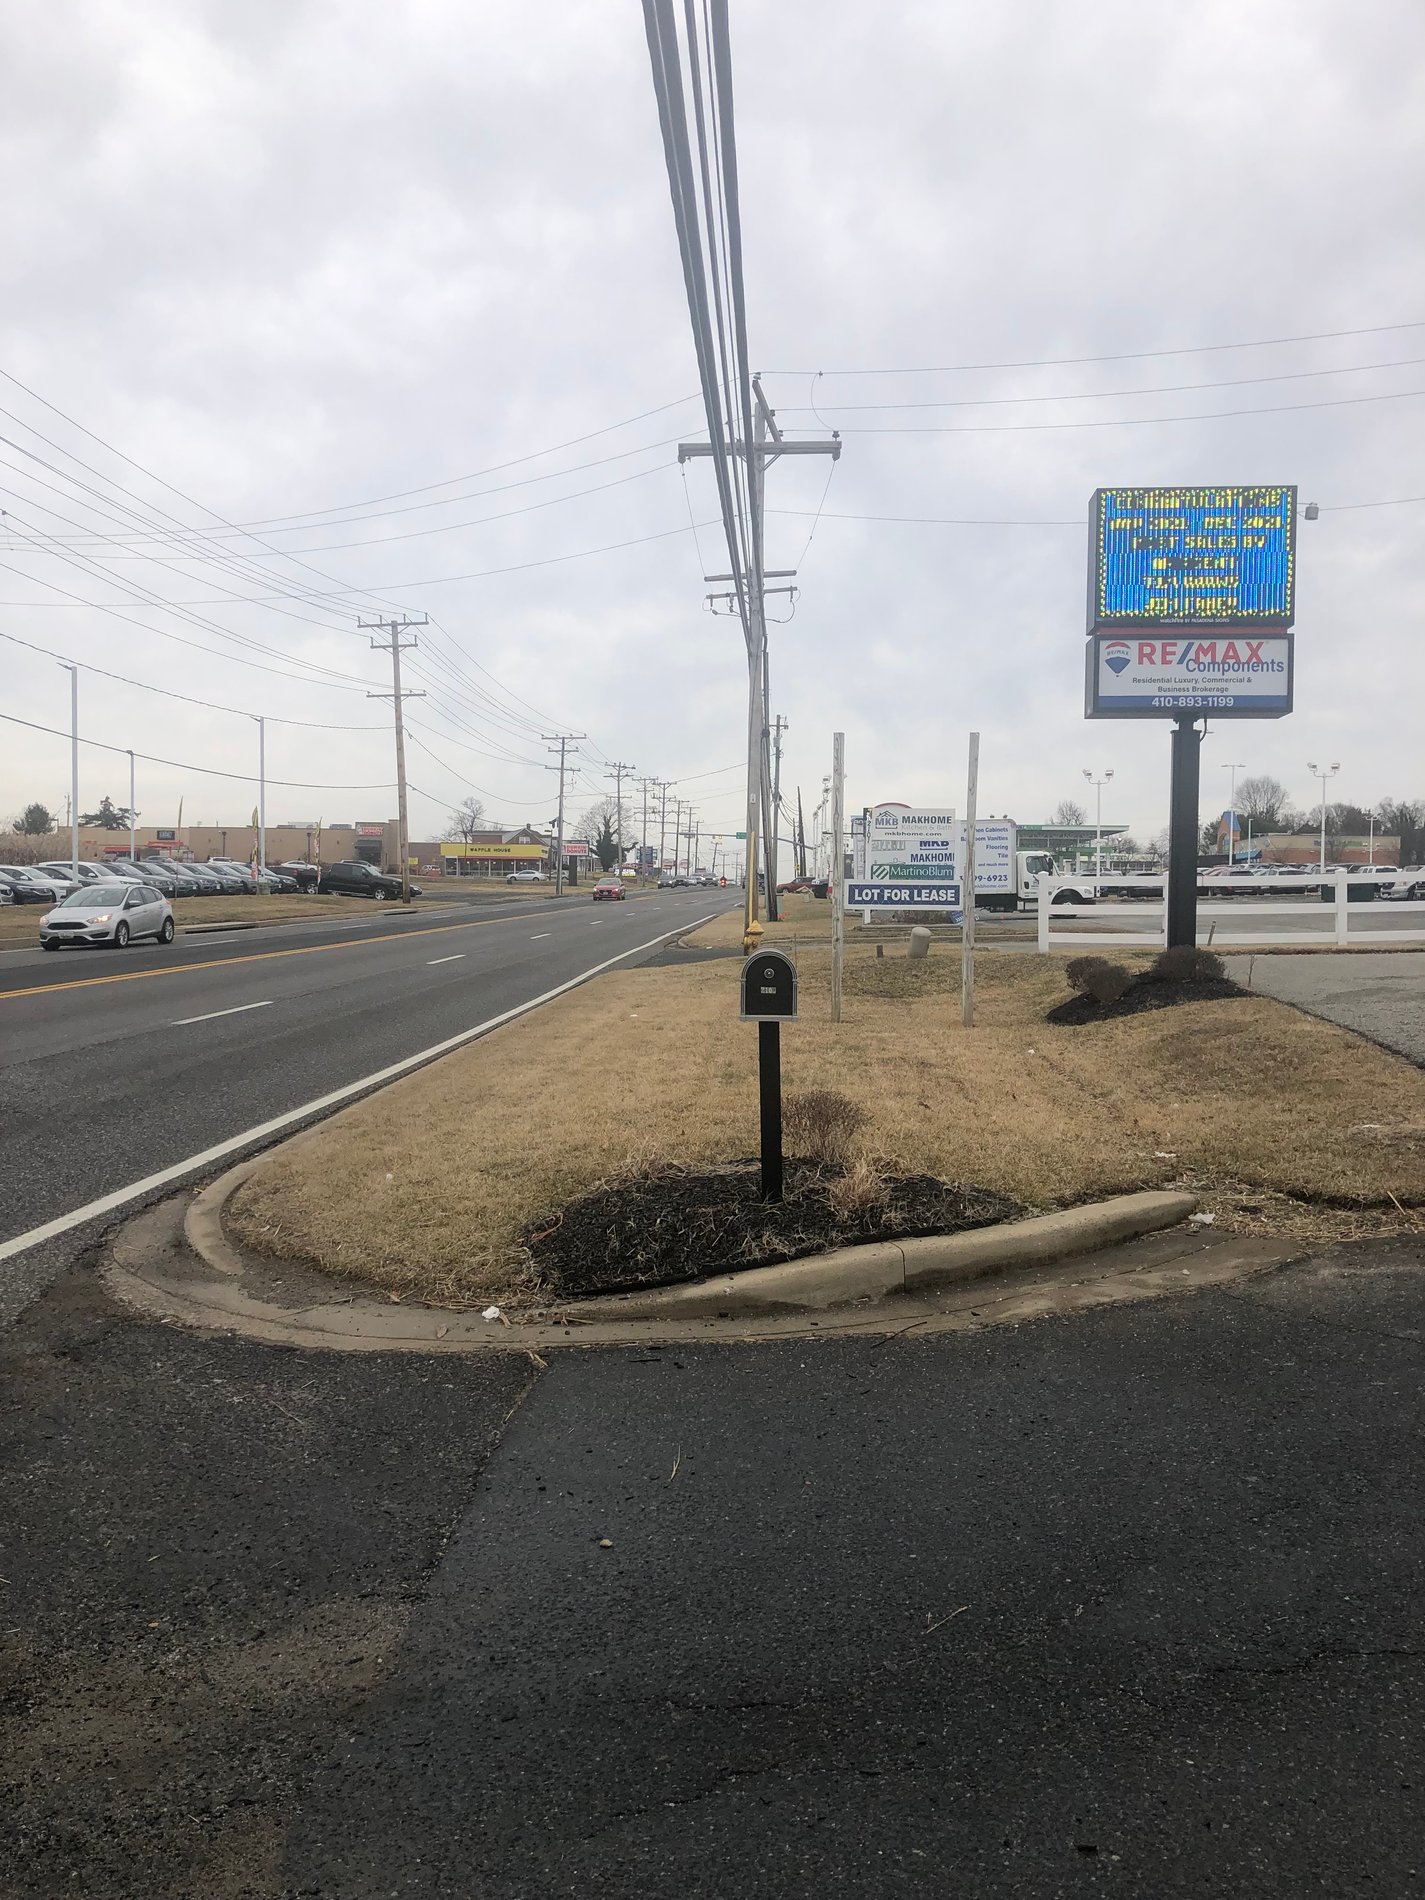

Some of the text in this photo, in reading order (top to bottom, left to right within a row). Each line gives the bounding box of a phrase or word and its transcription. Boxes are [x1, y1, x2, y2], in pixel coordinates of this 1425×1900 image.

[1137, 641, 1264, 665] RE/MAX
[1185, 658, 1284, 676] Components
[1191, 686, 1229, 694] Brokerage
[1151, 696, 1234, 707] 410-893-1199
[875, 816, 952, 826] MKB MAKHOME
[910, 853, 955, 863] MAKHOM
[890, 866, 953, 876] MartinoBlum
[854, 889, 956, 901] LOT FOR LEASE
